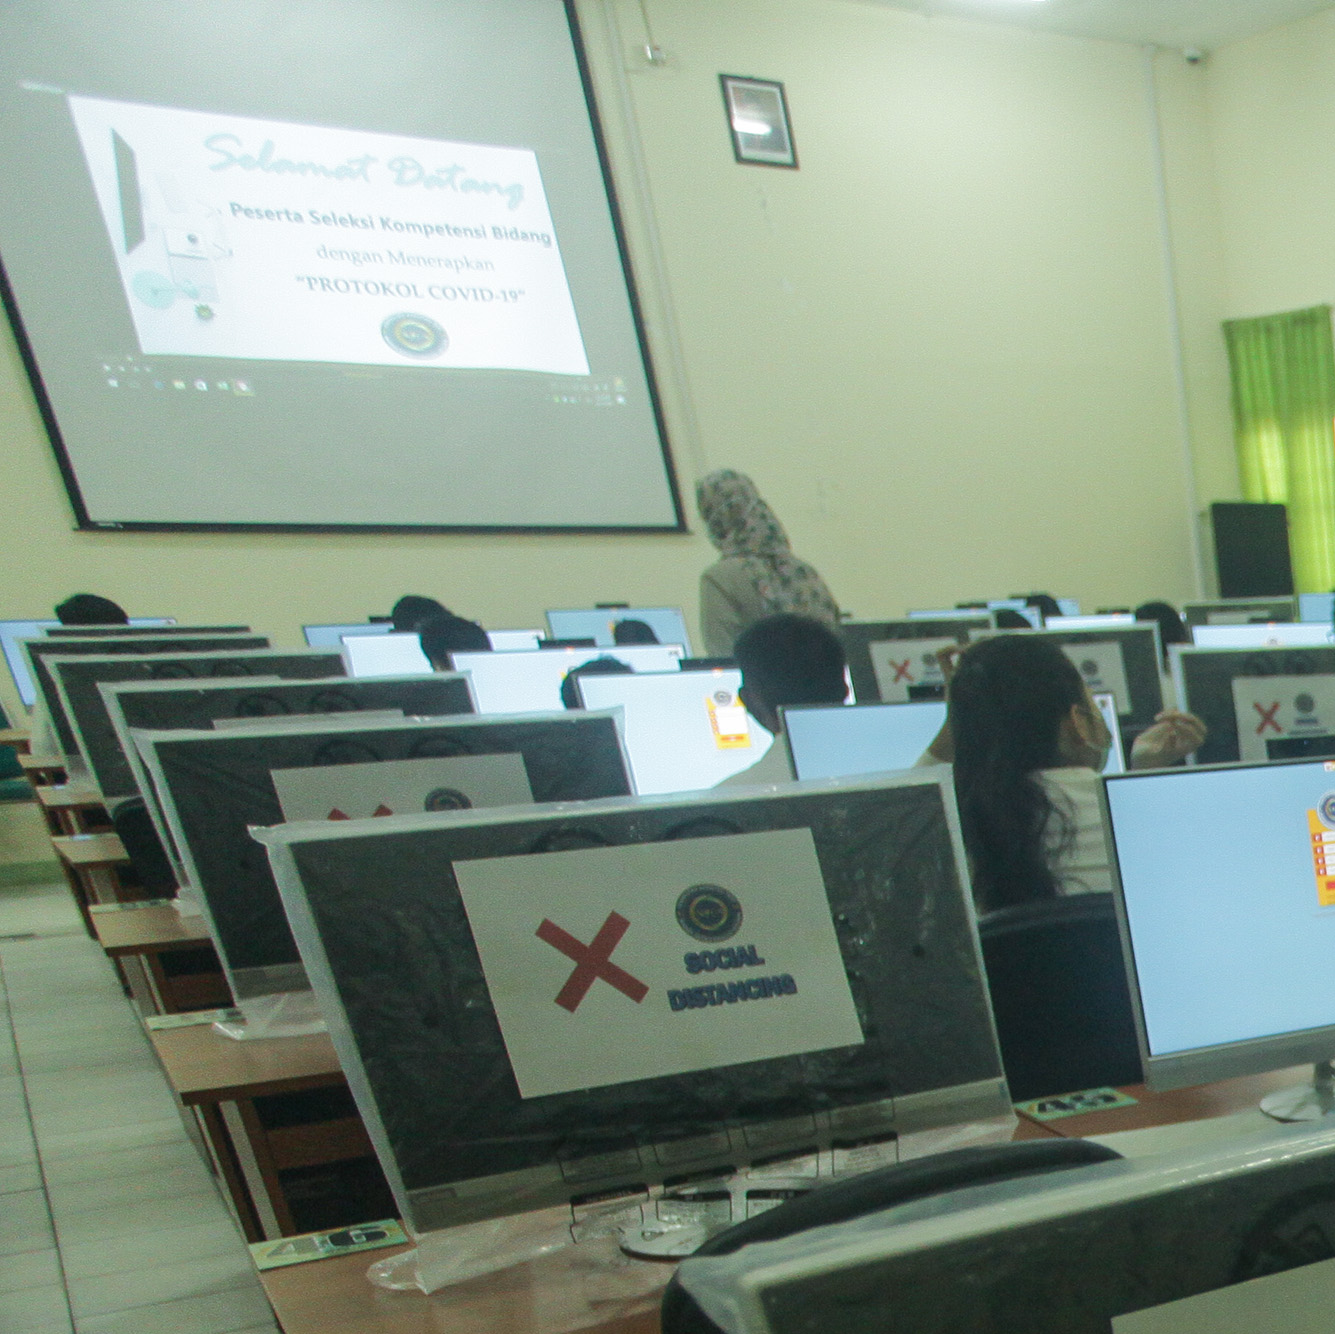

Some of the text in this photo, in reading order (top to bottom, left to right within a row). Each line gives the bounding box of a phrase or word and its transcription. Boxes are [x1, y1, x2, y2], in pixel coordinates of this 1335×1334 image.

[204, 133, 525, 210] Selamat Datang
[229, 202, 552, 248] Peserta Seleksi Kompetensi Bidang
[317, 243, 496, 274] dengan Menerapkan
[684, 944, 766, 975] SOCIAL
[667, 973, 798, 1013] DISTANCING
